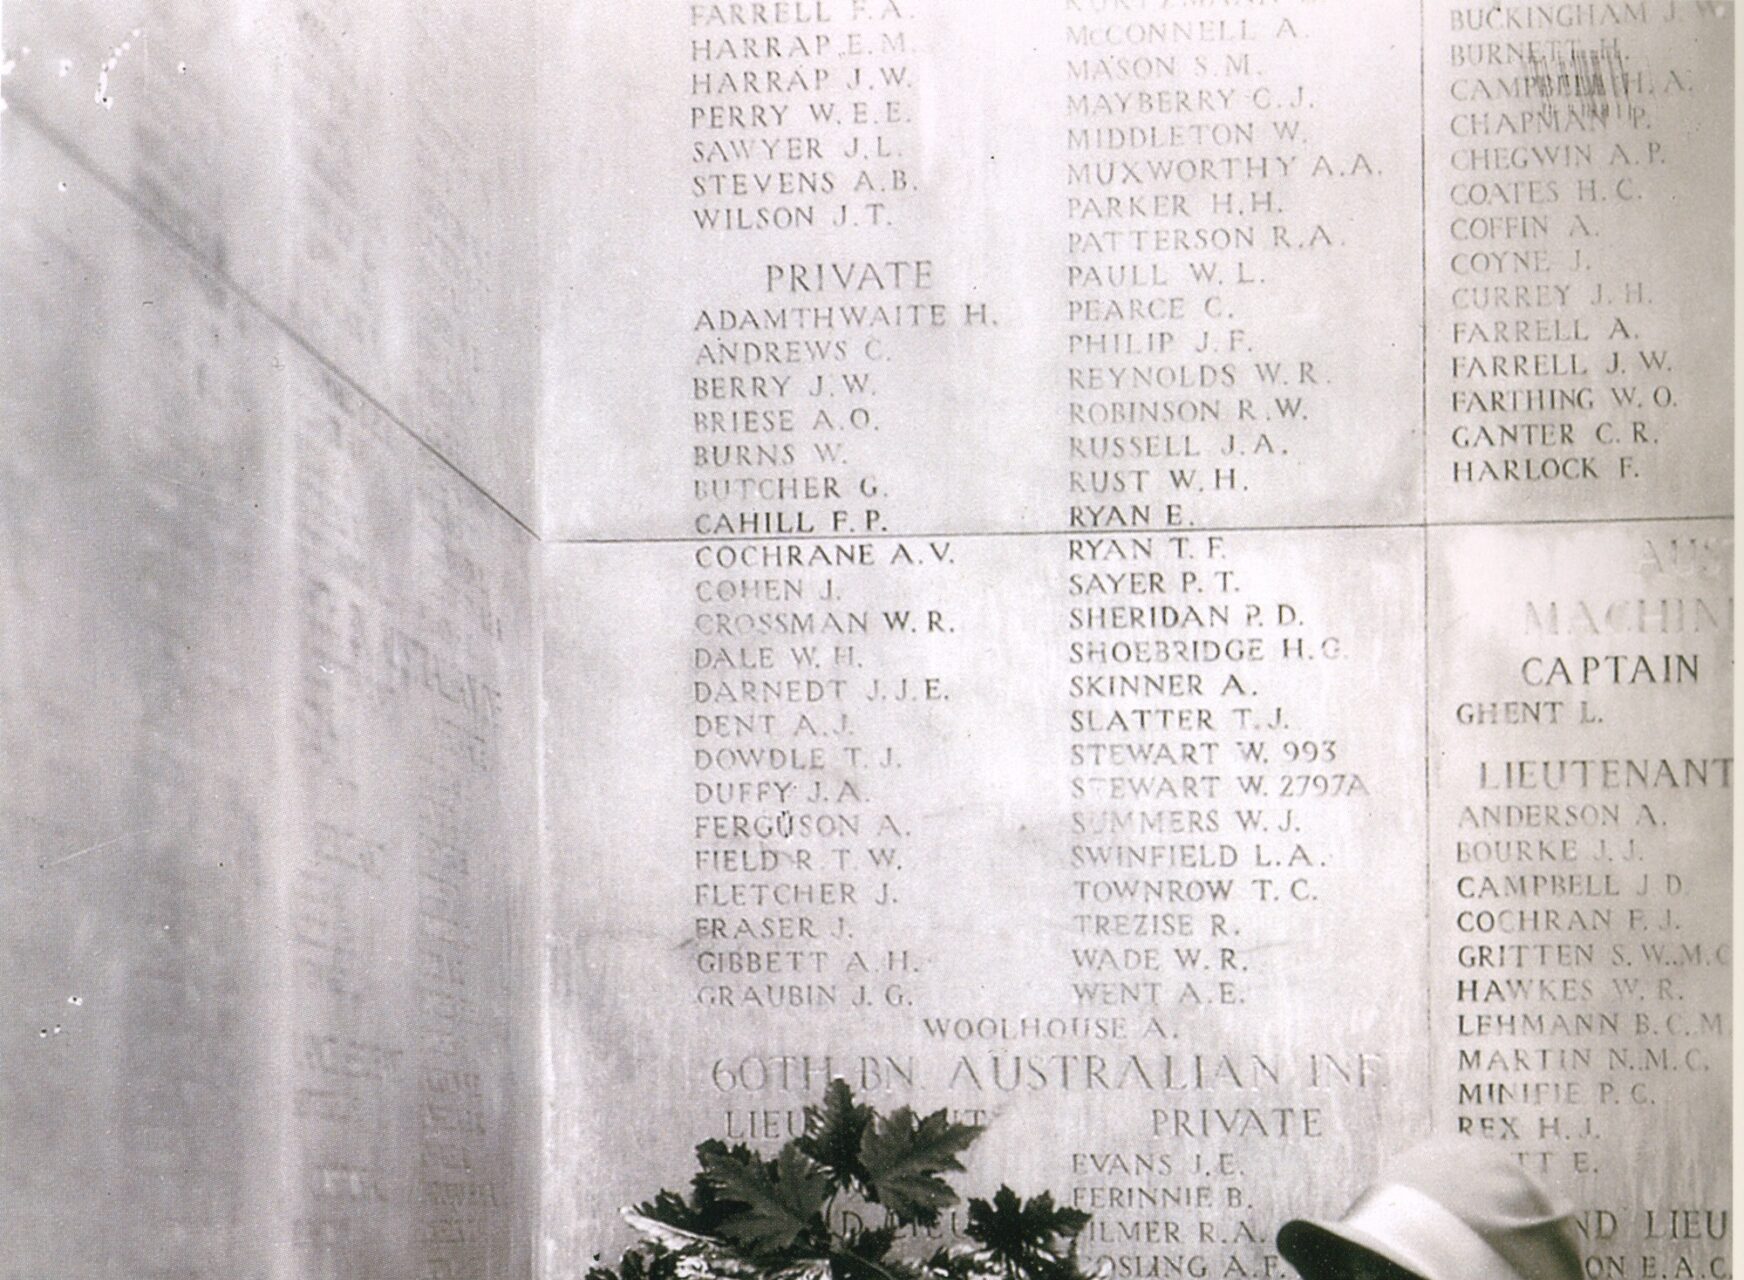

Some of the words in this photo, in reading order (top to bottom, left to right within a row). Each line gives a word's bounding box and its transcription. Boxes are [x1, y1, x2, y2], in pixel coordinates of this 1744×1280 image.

[691, 1, 831, 26] FARRELL
[1452, 3, 1647, 31] BUCKINGHAM
[1276, 18, 1308, 38] A.
[692, 35, 830, 61] HARRAP
[1068, 56, 1175, 81] MASON
[692, 68, 829, 94] HARRAP
[1068, 89, 1235, 116] MAYBERRY
[691, 105, 788, 128] PERRY
[1451, 108, 1609, 137] CHAPMAN
[1068, 123, 1254, 150] MIDDLETON
[1273, 121, 1307, 144] W.
[693, 138, 823, 162] SAWYER
[1452, 145, 1591, 171] CHEGWIN
[1068, 156, 1296, 185] MUXWORTHY
[693, 171, 834, 197] STEVENS
[1451, 181, 1559, 206] COATES
[693, 206, 815, 230] WILSON
[1068, 195, 1192, 219] PARKER
[1451, 216, 1548, 240] COFFIN
[1569, 214, 1599, 237] A.
[1068, 228, 1256, 252] PATTERSON
[1452, 251, 1549, 275] COYNE
[1571, 250, 1591, 271] J.
[766, 260, 932, 293] PRIVATE
[1068, 264, 1168, 287] PAULL
[1452, 284, 1570, 309] CURREY
[694, 304, 947, 331] ADAMTHWAITE
[965, 304, 998, 326] H.
[1068, 299, 1184, 321] PEARCE
[1205, 297, 1234, 319] C.
[1454, 319, 1589, 343] FARRELL
[1608, 317, 1639, 339] A.
[696, 341, 848, 364] ANDREWS
[865, 339, 891, 362] C.
[1069, 332, 1174, 353] PHILIP
[1069, 364, 1237, 390] REYNOLDS
[1453, 354, 1587, 378] FARRELL
[693, 375, 791, 399] BERRY
[1452, 387, 1594, 412] FARTHING
[693, 409, 794, 433] BRIESE
[1069, 401, 1221, 425] ROBINSON
[1069, 436, 1200, 459] RUSSELL
[1452, 424, 1575, 447] GANTER
[694, 444, 795, 467] BURNS
[814, 443, 847, 464] W.
[1454, 457, 1599, 482] HARLOCK
[1620, 457, 1639, 478] F.
[694, 476, 841, 500] BUTCHER
[859, 477, 888, 498] G.
[1070, 471, 1149, 493] RUST
[695, 511, 814, 534] CAHILL
[1070, 505, 1150, 528] RYAN
[1167, 504, 1194, 526] E.
[696, 543, 875, 568] COCHRANE
[1069, 538, 1152, 560] RYAN
[696, 579, 804, 602] COHEN
[820, 579, 841, 601] J.
[1069, 573, 1166, 596] SAYER
[696, 611, 869, 636] CROSSMAN
[1070, 606, 1229, 629] SHERIDAN
[694, 647, 774, 669] DALE
[1070, 639, 1264, 663] SHOEBRIDGE
[1522, 655, 1698, 686] CAPTAIN
[694, 680, 848, 703] DARNEDT
[1070, 674, 1203, 698] SKINNER
[1221, 674, 1257, 696] A.
[1071, 709, 1213, 732] SLATTER
[1456, 700, 1563, 725] GHENT
[1580, 701, 1602, 723] L.
[695, 714, 776, 737] DENT
[696, 748, 824, 771] DOWDLE
[1071, 742, 1219, 767] STEWART
[1236, 742, 1268, 763] W.
[1283, 740, 1336, 763] 993
[1480, 758, 1733, 790] LIEUTENANT
[695, 782, 791, 804] DUFFY
[1071, 776, 1220, 799] STEWART
[1238, 776, 1267, 797] W.
[1280, 774, 1370, 798] 2797A
[695, 814, 860, 839] FERGUSON
[878, 815, 910, 837] A.
[1458, 804, 1619, 829] ANDERSON
[1636, 803, 1666, 826] A.
[696, 849, 778, 872] FIELD
[1071, 845, 1238, 868] SWINFIELD
[1457, 840, 1577, 863] BOURKE
[696, 883, 856, 907] FLETCHER
[876, 883, 898, 904] J.
[1074, 879, 1233, 902] TOWNROW
[1458, 875, 1620, 899] CAMPBELL
[696, 918, 815, 939] FRASER
[830, 918, 852, 938] J.
[1074, 914, 1194, 937] TREZISE
[1211, 914, 1239, 936] R.
[1457, 909, 1611, 933] COCHRAN
[698, 951, 828, 973] GIBBETT
[1072, 949, 1159, 971] WADE
[1458, 944, 1593, 968] GRITTEN
[698, 985, 836, 1008] GRAUBIN
[1073, 982, 1162, 1006] WENT
[1457, 979, 1593, 1002] HAWKES
[924, 1017, 1127, 1040] WOOLHOUSE
[1144, 1017, 1178, 1039] A.
[1458, 1014, 1618, 1036] LEHMANN
[1458, 1049, 1591, 1071] MARTIN
[711, 1056, 833, 1093] 60TH
[951, 1054, 1279, 1091] AUSTRALIAN
[1458, 1083, 1580, 1104] MINIFIE
[1152, 1108, 1323, 1138] PRIVATE
[1458, 1117, 1519, 1140] REX
[1072, 1153, 1171, 1176] EVANS
[1073, 1187, 1212, 1209] FERINNIE
[1228, 1187, 1253, 1208] B.
